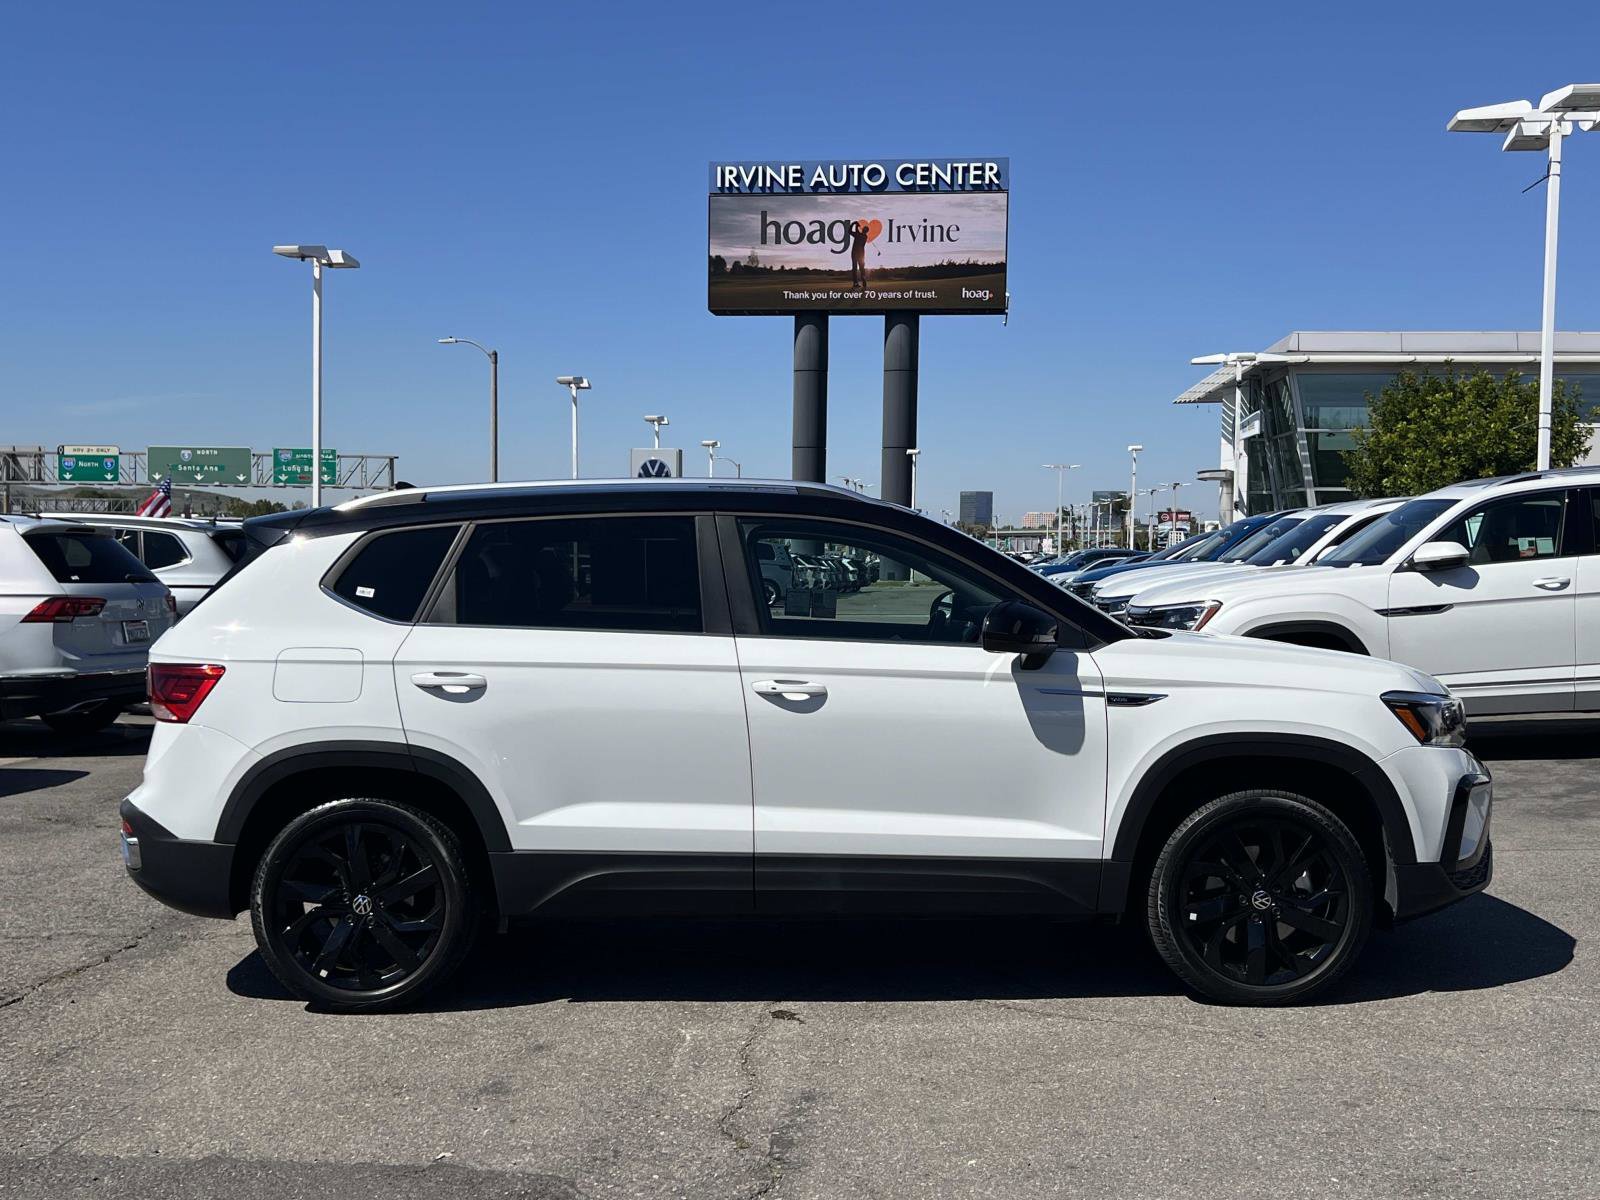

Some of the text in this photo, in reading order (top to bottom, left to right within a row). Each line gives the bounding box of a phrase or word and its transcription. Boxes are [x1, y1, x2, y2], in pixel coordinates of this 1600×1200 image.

[716, 162, 1000, 188] IRVINE AUTO CENTER
[760, 210, 960, 254] hoag Irvine
[783, 290, 809, 299] Thank
[811, 292, 827, 300] you
[829, 290, 841, 299] for
[864, 290, 876, 299] 70
[878, 291, 902, 300] years
[903, 290, 912, 298] of
[915, 290, 937, 298] trust.
